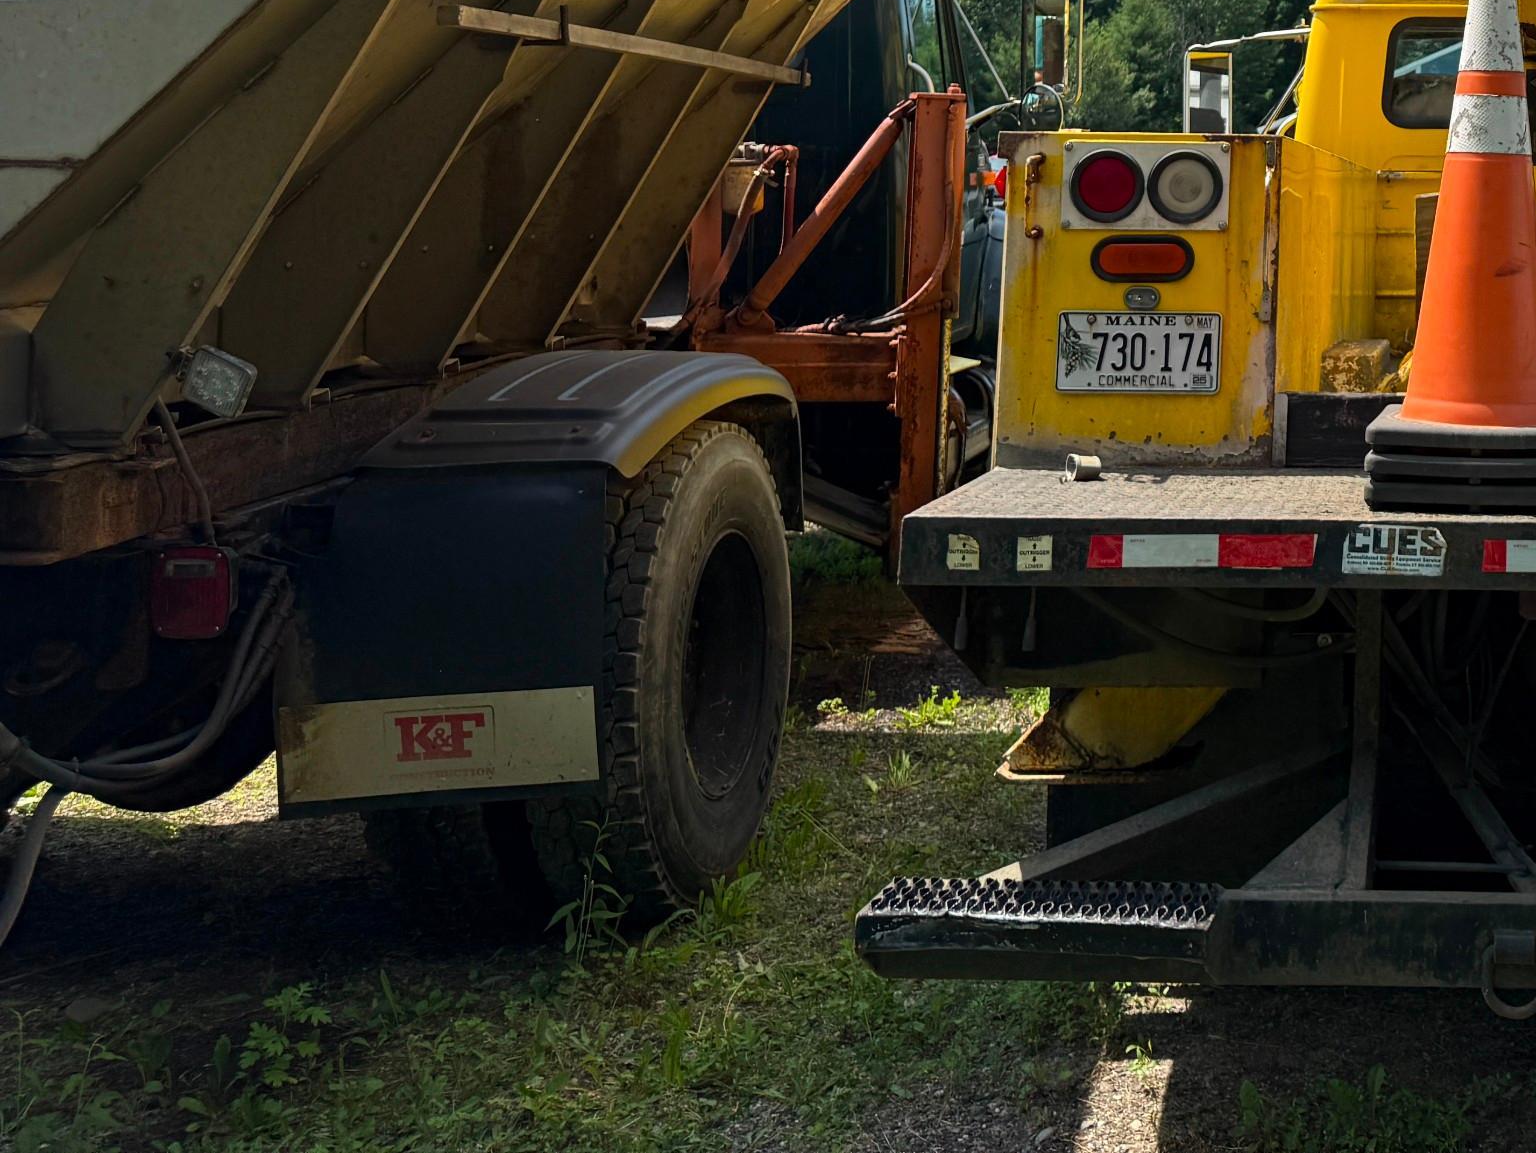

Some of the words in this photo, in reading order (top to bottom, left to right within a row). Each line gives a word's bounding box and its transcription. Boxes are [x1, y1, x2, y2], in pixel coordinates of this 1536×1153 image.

[1105, 315, 1177, 326] MAINE
[1196, 317, 1212, 328] MAY
[1098, 374, 1175, 387] COMMERCIAL
[1348, 528, 1443, 556] CUES
[394, 712, 485, 762] K&F
